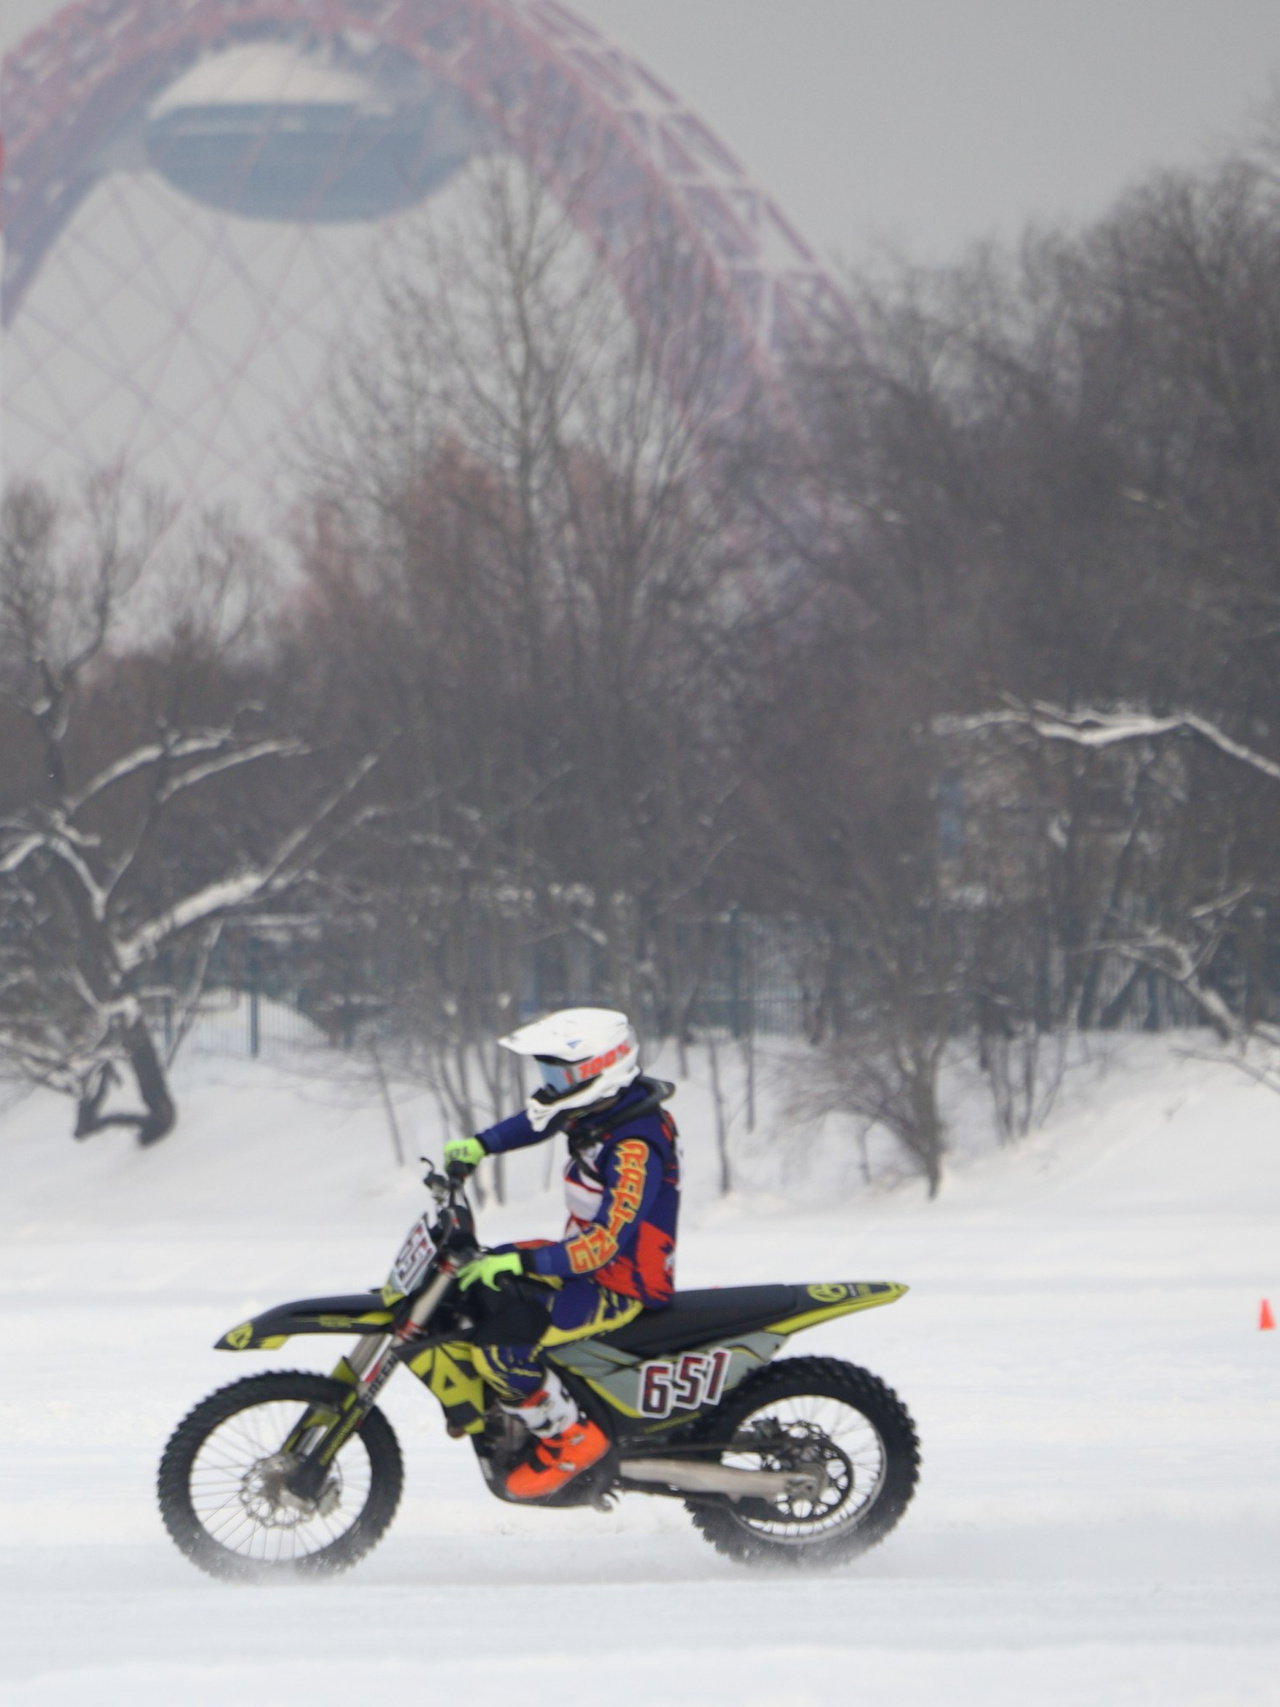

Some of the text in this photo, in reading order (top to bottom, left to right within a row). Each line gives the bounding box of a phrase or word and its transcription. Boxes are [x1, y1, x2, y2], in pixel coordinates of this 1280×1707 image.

[578, 1041, 631, 1080] 100%
[567, 1138, 650, 1274] RACING
[639, 1349, 730, 1419] 651
